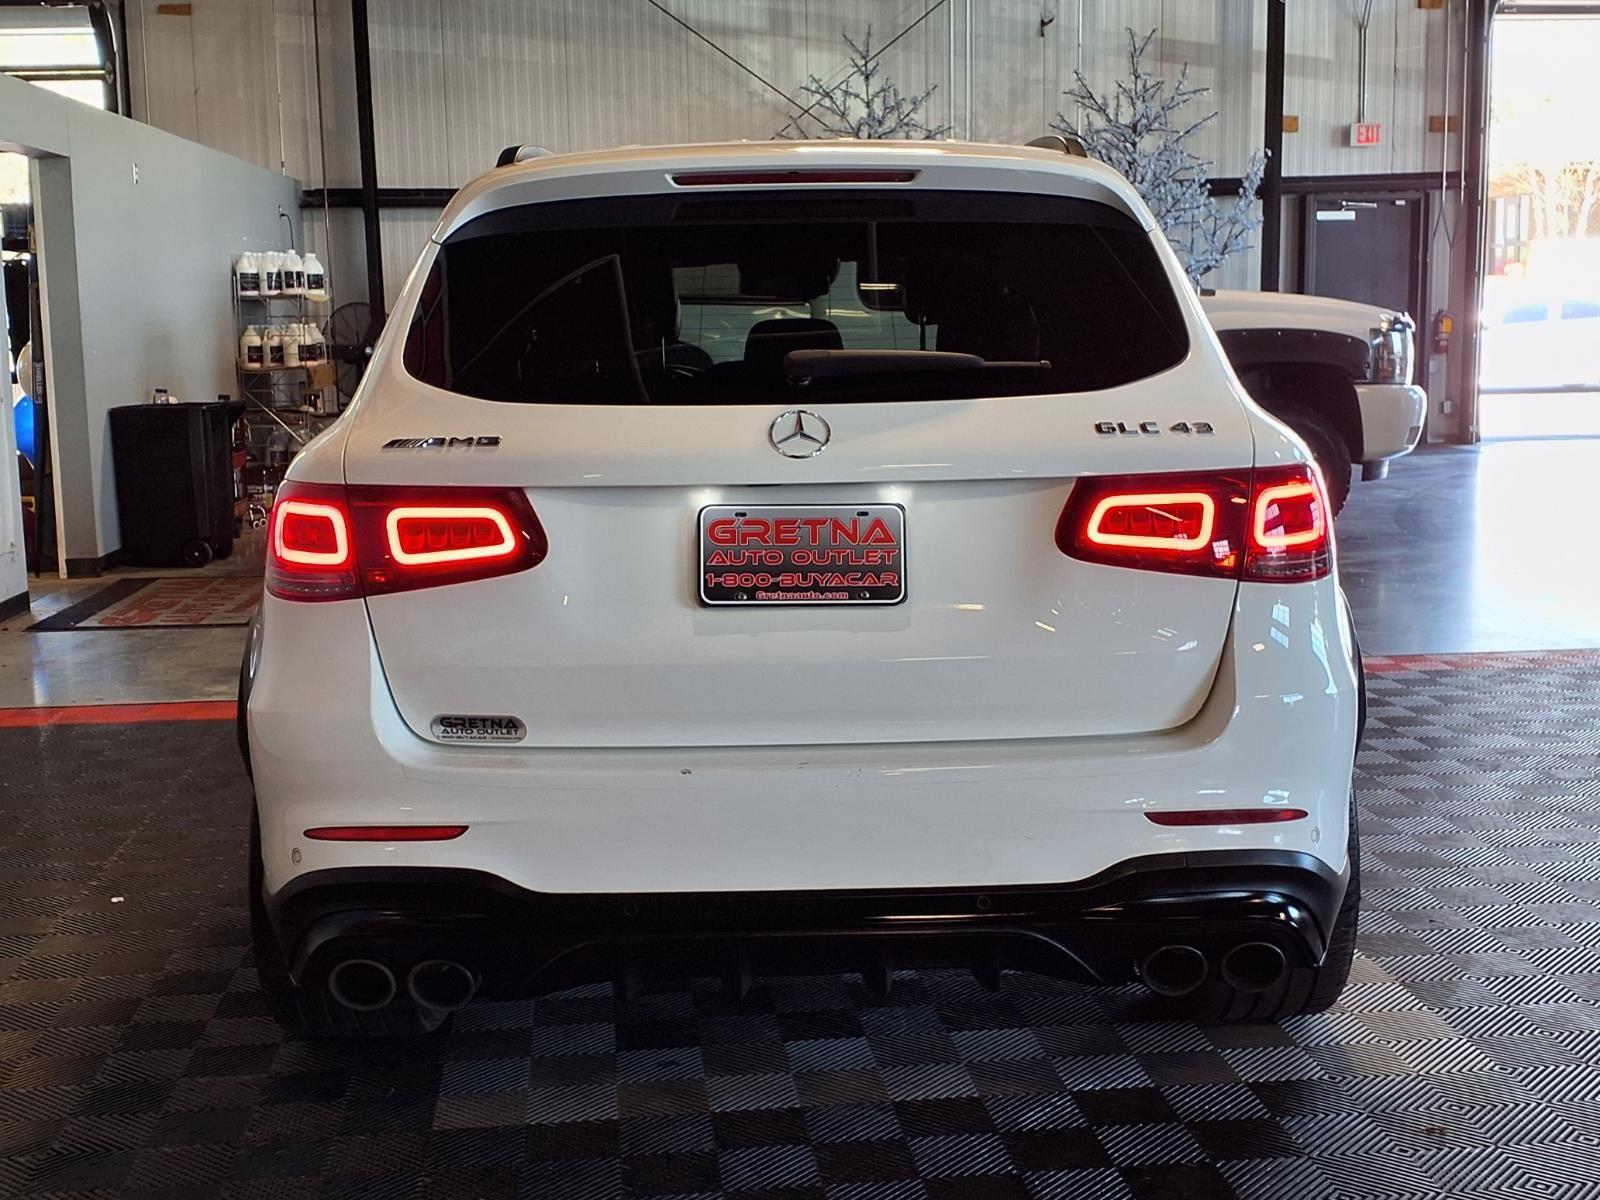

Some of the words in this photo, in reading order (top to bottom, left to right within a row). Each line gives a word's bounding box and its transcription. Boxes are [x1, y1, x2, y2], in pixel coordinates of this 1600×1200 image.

[1357, 124, 1381, 144] EXIT
[1095, 421, 1161, 435] GLC
[1169, 421, 1215, 435] 43
[707, 517, 898, 546] GRETNA
[706, 549, 784, 566] AUTO
[791, 549, 899, 566] OUTLET
[705, 572, 899, 587] 1-800-BUYACAR
[755, 590, 849, 600] Gretnaauto.com
[440, 716, 518, 729] GRETNA
[477, 728, 519, 736] OUTLET
